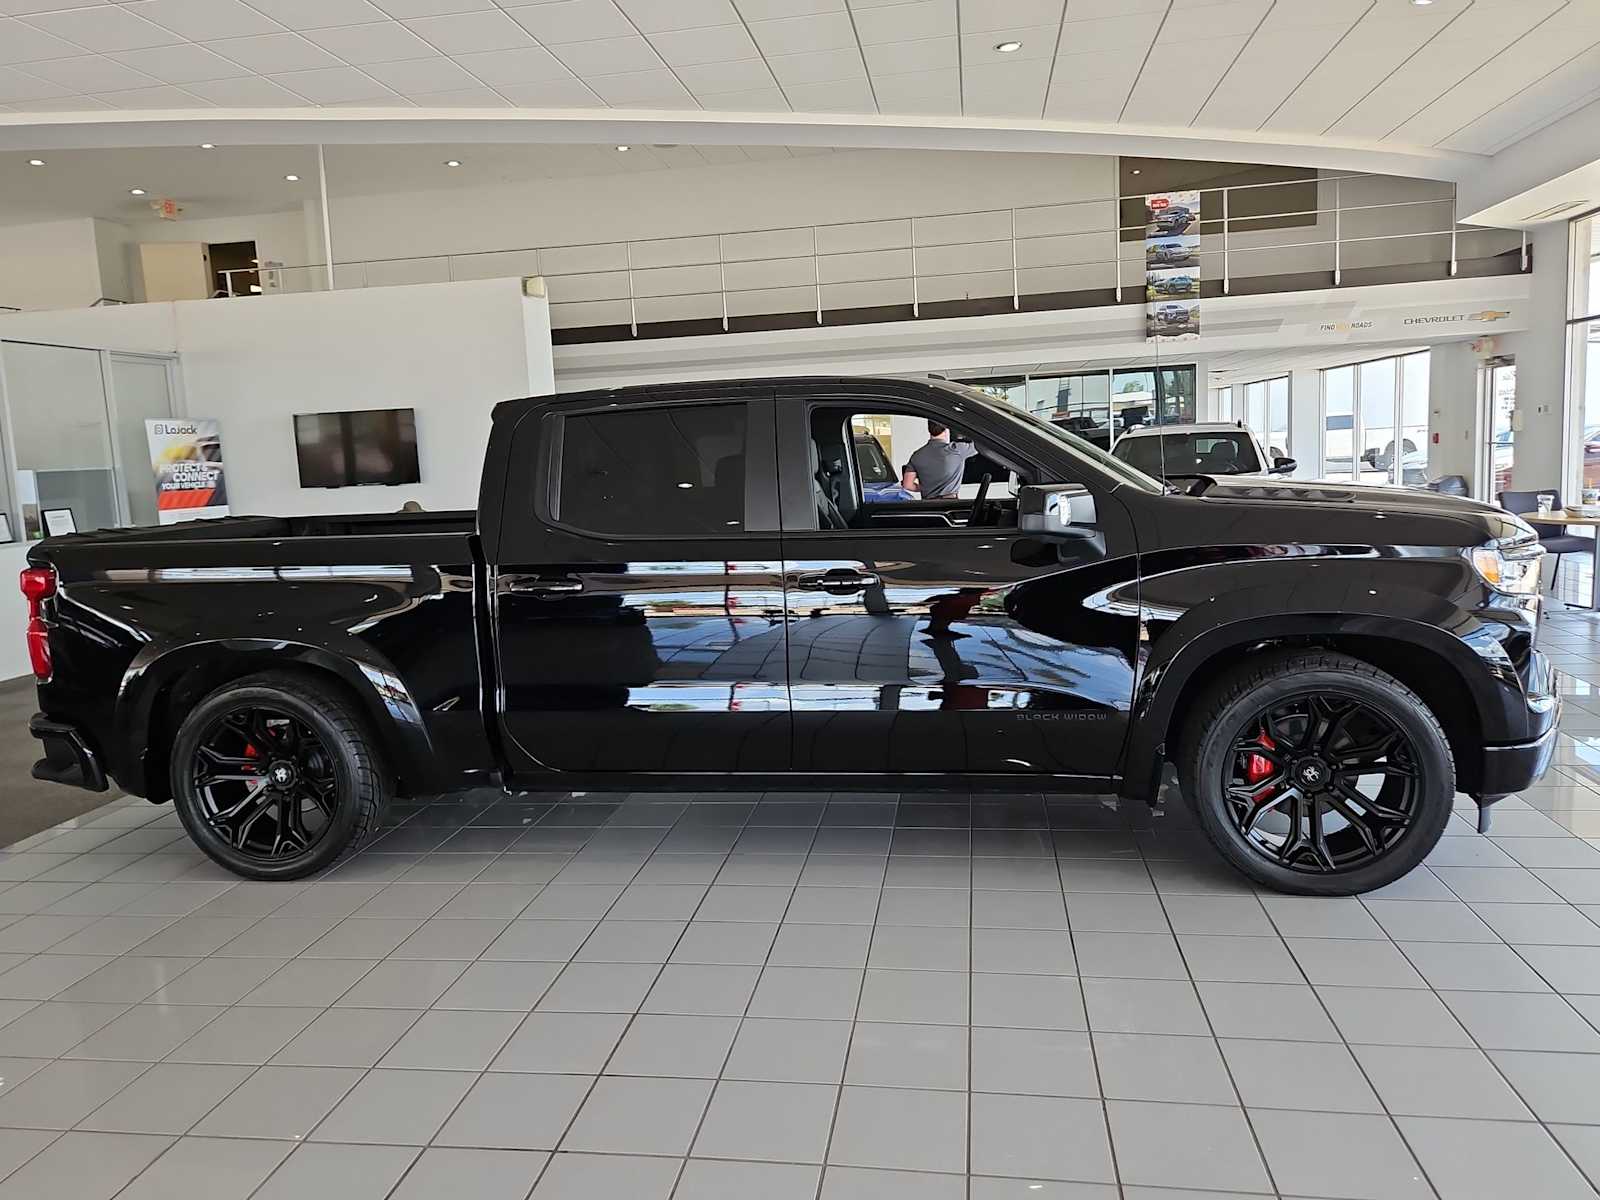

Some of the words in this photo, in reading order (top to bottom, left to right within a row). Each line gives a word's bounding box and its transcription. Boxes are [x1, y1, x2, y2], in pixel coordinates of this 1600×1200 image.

[1403, 314, 1464, 325] CHEVROLET
[173, 471, 219, 482] CONNECT
[1016, 713, 1060, 721] BLACK
[1063, 713, 1107, 721] WIDOW
